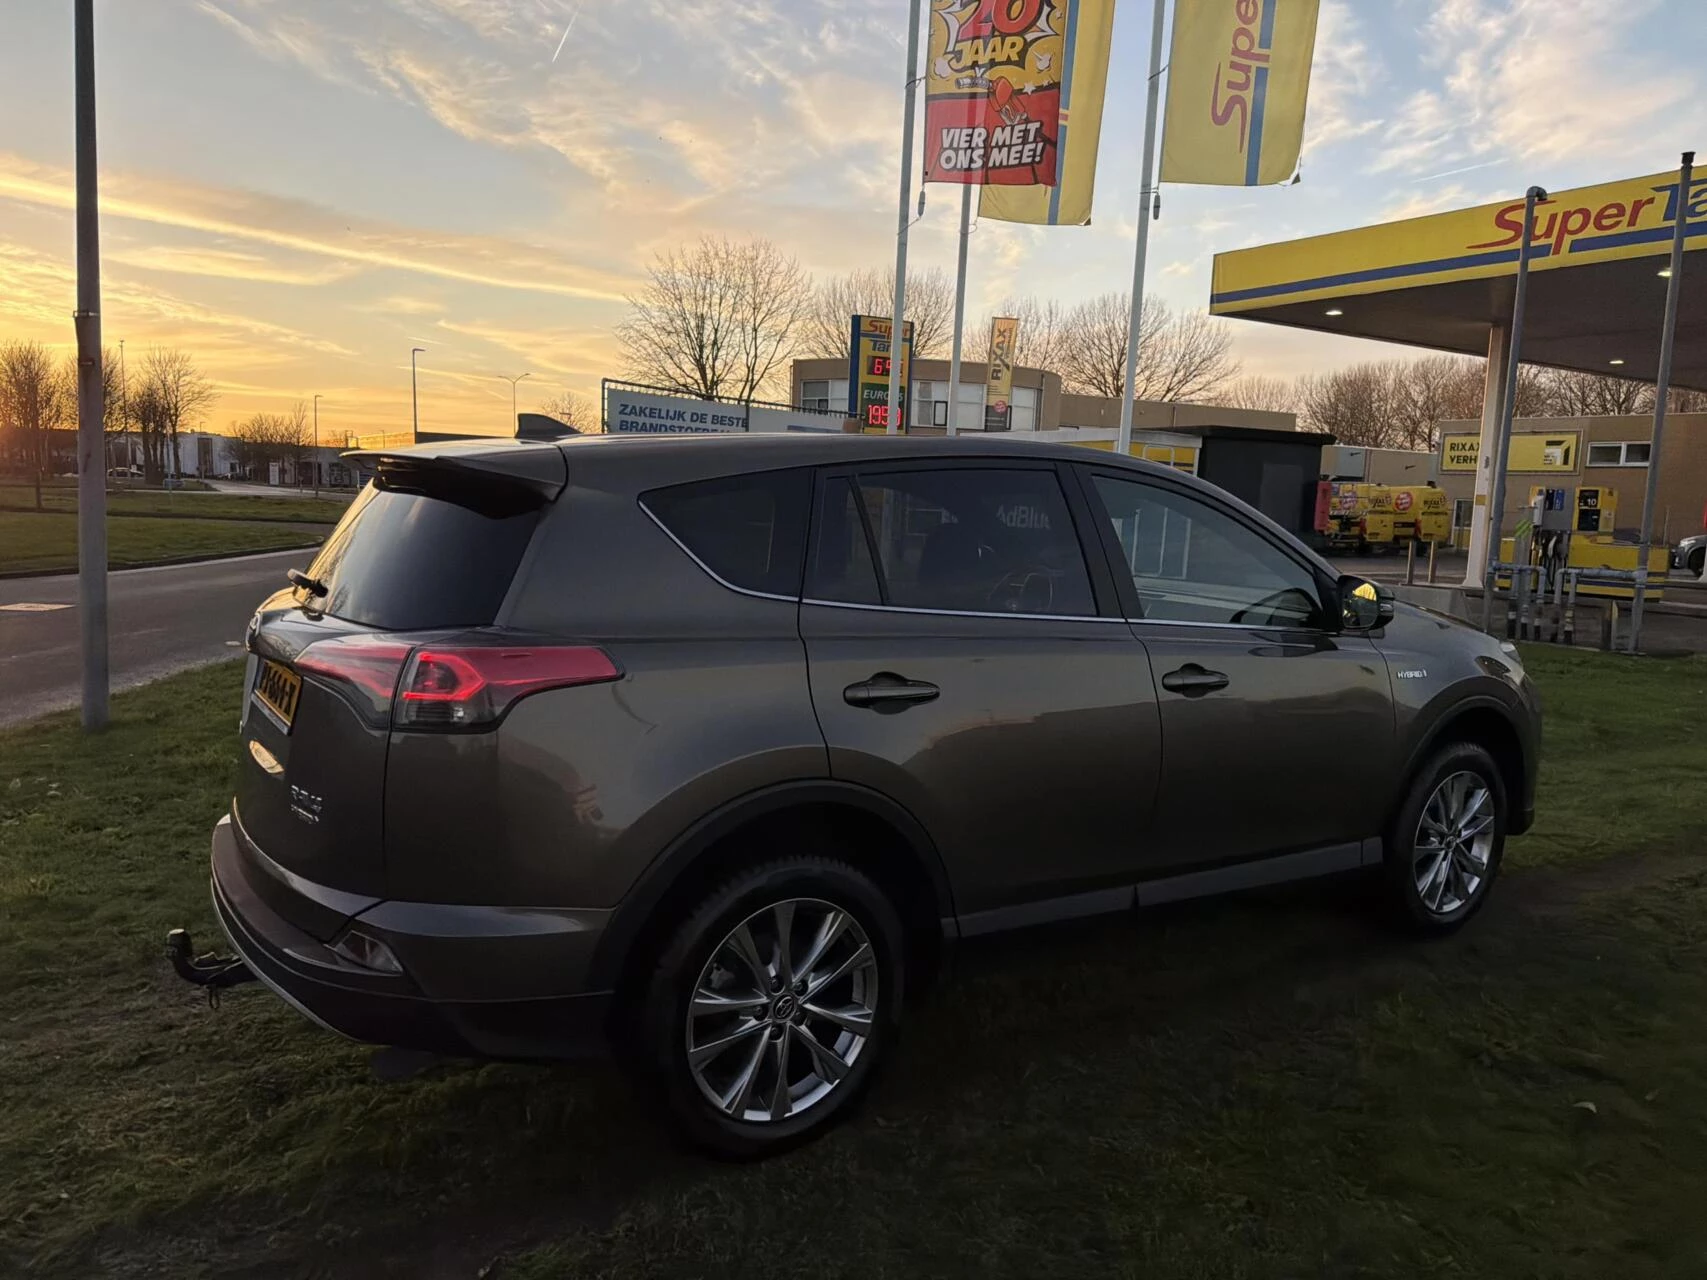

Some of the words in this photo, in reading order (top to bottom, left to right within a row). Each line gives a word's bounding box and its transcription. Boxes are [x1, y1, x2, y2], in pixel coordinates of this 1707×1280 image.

[949, 36, 1025, 70] JAAR
[942, 127, 988, 149] VIER
[990, 121, 1042, 147] MET
[939, 149, 986, 170] ONS
[988, 142, 1044, 167] MEE!
[619, 404, 686, 422] ZAKELIJK
[690, 412, 708, 424] DE
[711, 415, 748, 428] BESTE
